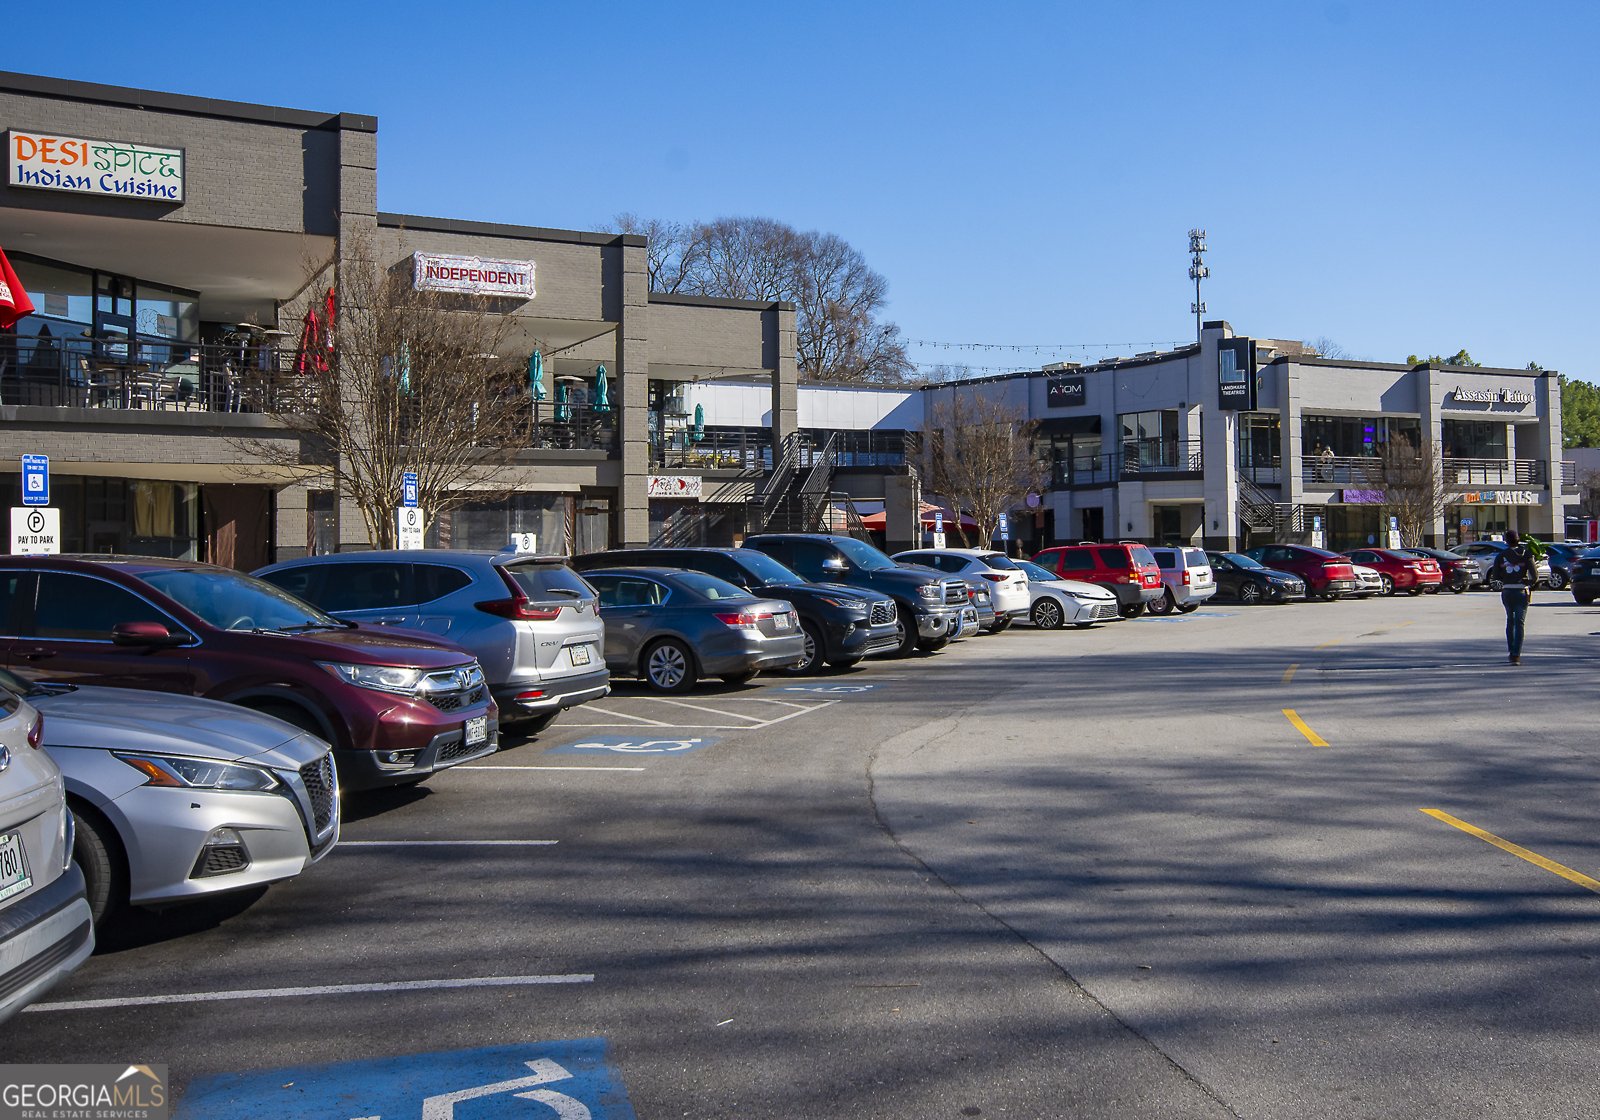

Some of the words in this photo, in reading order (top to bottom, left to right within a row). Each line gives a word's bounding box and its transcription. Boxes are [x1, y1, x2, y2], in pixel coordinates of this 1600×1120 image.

[13, 135, 88, 167] DESI
[17, 164, 91, 190] Indian
[99, 173, 178, 199] Cuisine
[425, 265, 527, 286] INDEPENDENT
[1221, 384, 1247, 392] LANDMARK
[1453, 385, 1500, 402] Assassin
[1501, 387, 1536, 403] Tattoo
[1495, 490, 1533, 505] NAILS
[17, 535, 29, 545] PAY
[30, 535, 38, 545] TO
[39, 535, 54, 545] PARK
